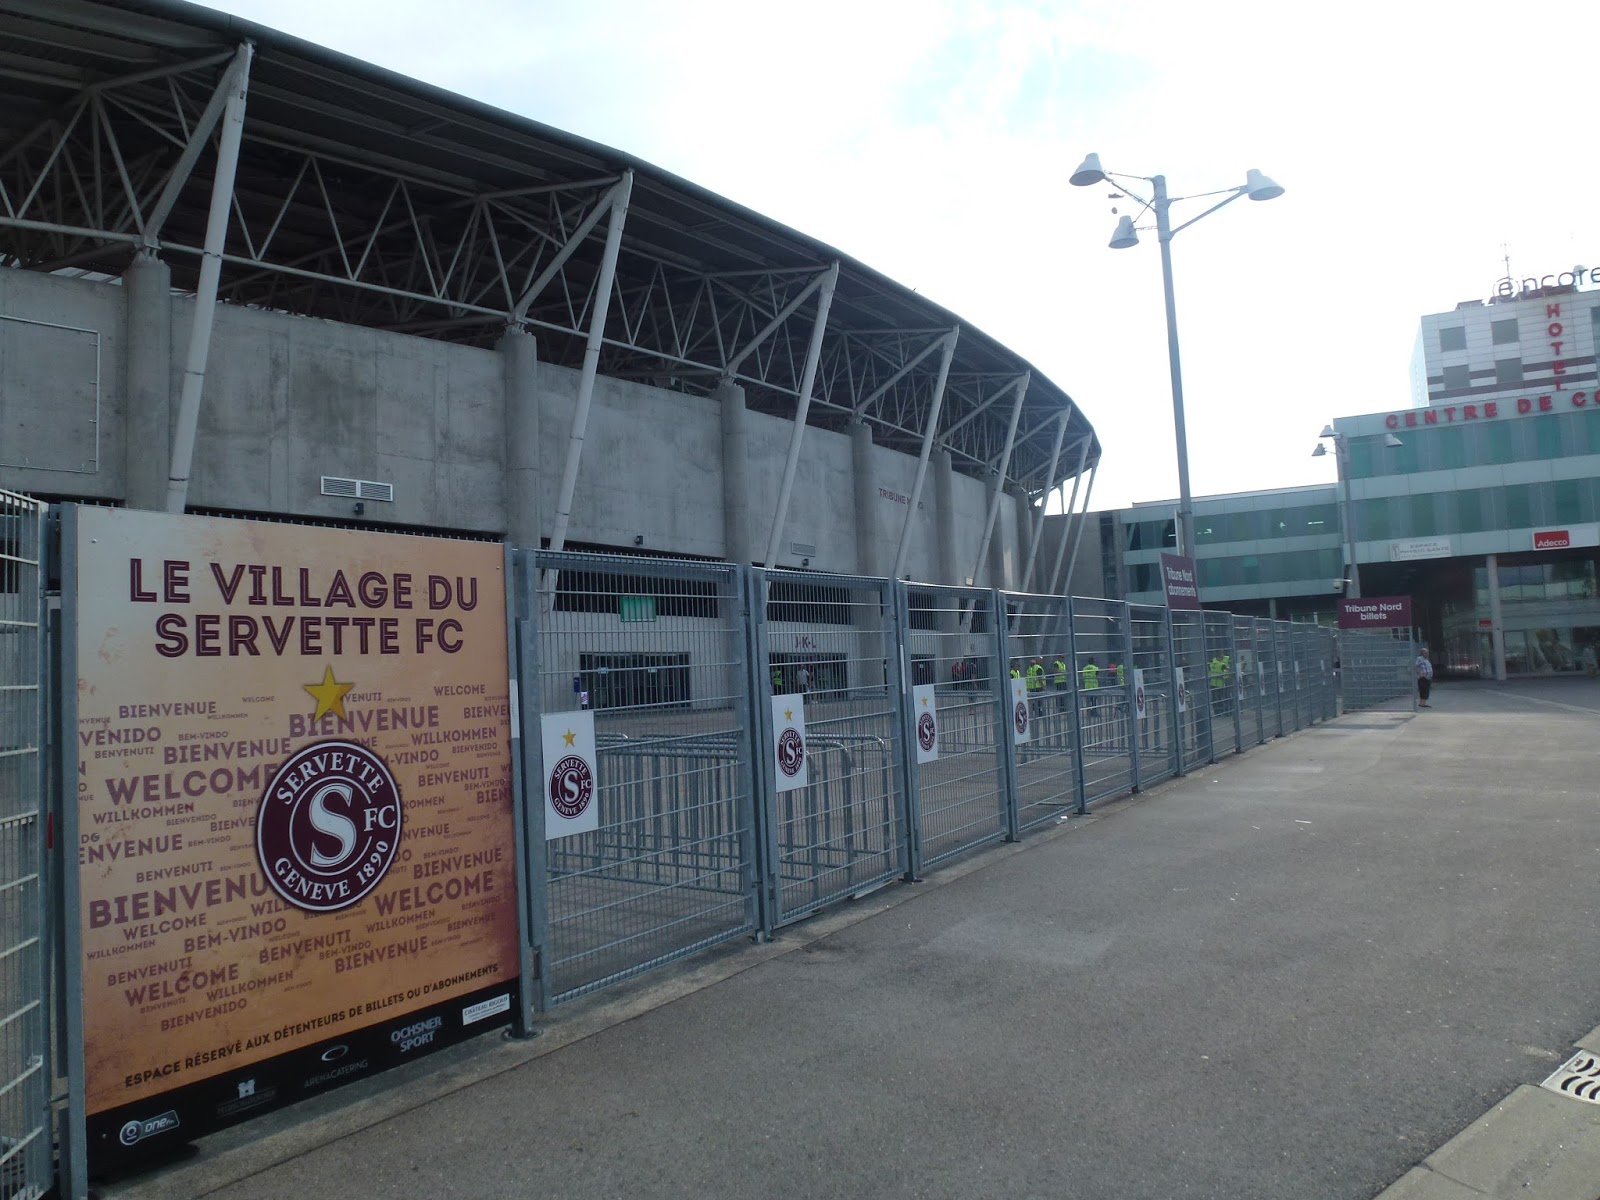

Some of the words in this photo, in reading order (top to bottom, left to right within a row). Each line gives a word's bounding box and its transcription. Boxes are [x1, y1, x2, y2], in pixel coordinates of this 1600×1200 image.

[1546, 304, 1567, 391] HOTEL
[1386, 402, 1497, 429] CENTRE
[1518, 396, 1552, 413] DE
[879, 488, 905, 505] TRIBUNE
[1537, 539, 1568, 547] Adecco
[130, 559, 190, 604] LE
[210, 563, 412, 609] VILLAGE
[428, 575, 477, 611] DU
[1360, 612, 1387, 620] billets
[1379, 603, 1402, 611] Nord
[155, 614, 400, 657] SERVETTE
[415, 618, 464, 654] FC
[434, 685, 485, 696] WELCOME
[119, 702, 216, 718] BIENVENUE
[289, 706, 439, 738] BIENVENUE
[79, 727, 161, 747] VENIDO
[179, 731, 228, 741] BEM-VINDO
[411, 727, 497, 746] WILLKOMMEN
[95, 747, 154, 759] BENVENUTI
[164, 738, 291, 765] BIENVENUE
[452, 742, 497, 754] BIENVENIDO
[276, 752, 384, 805] SERVETTE
[418, 767, 489, 787] BENVENUTI
[555, 759, 587, 779] SERVETTE
[581, 779, 592, 790] FC
[554, 798, 577, 815] GENEVE
[579, 792, 589, 810] 1890
[93, 803, 194, 824] WILLKOMMEN
[166, 814, 216, 826] BIENVENIDO
[309, 783, 357, 867] S
[363, 805, 396, 832] FC
[188, 836, 231, 848] BEM-VINDO
[136, 861, 213, 883] BENVENUTI
[356, 842, 389, 885] 1890
[414, 848, 502, 879] BIENVENUE
[274, 857, 351, 900] GENEVE
[374, 871, 494, 917] WELCOME
[123, 913, 206, 941] WELCOME
[366, 909, 435, 933] WILLKOMMEN
[447, 912, 495, 932] BIENVENUE
[184, 918, 287, 953] BEM-VINDO
[259, 929, 351, 964] BENVENUTI
[87, 939, 155, 960] WILLKOMMEN
[319, 940, 371, 960] BEM-VINDO
[335, 936, 428, 974] BIENVENUE
[108, 957, 192, 986] BENVENUTI
[125, 963, 239, 1007] WELCOME
[206, 970, 293, 1002] WILLKOMMEN
[126, 1061, 180, 1088] ESPACE
[185, 1041, 242, 1069] RÉSERVÉ
[246, 1034, 270, 1050] AUX
[274, 1011, 345, 1042] DÉTENTEURS
[349, 1005, 363, 1018] DE
[366, 993, 404, 1013] BILLETS
[407, 986, 420, 998] OU
[424, 964, 498, 994] D'ABONNEMENTS
[160, 998, 247, 1031] BIENVENIDO
[391, 1016, 442, 1043] OCHSNER
[400, 1031, 435, 1053] SPORT
